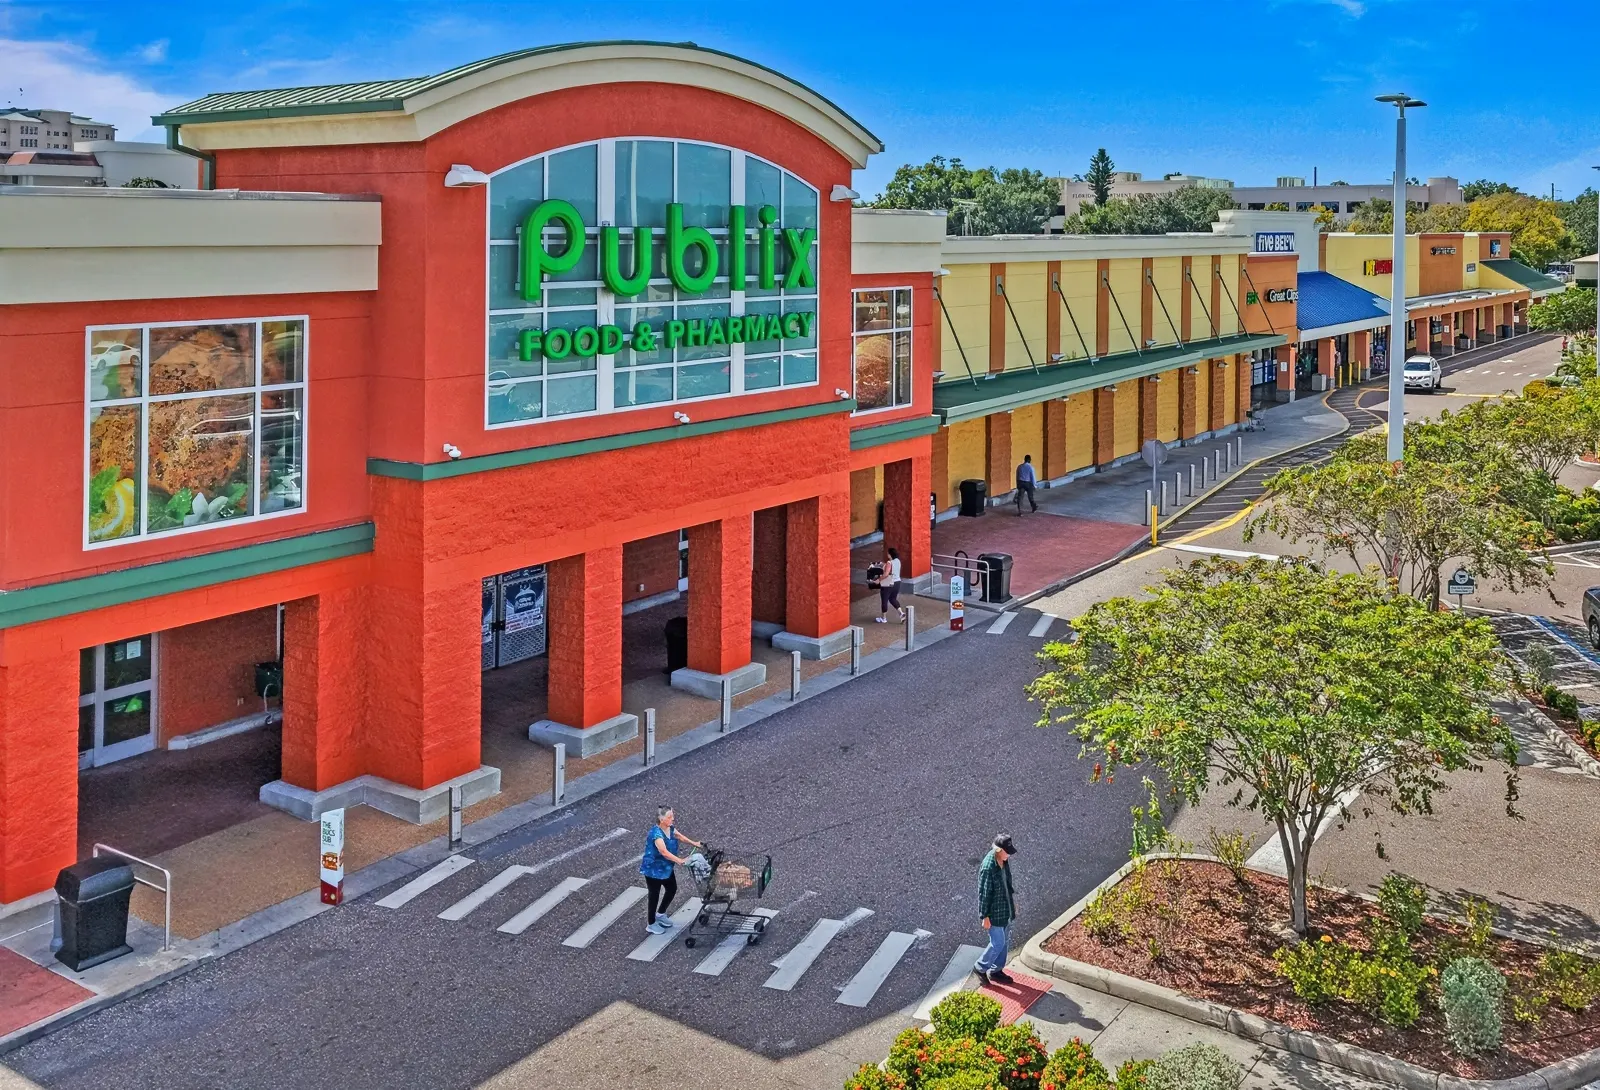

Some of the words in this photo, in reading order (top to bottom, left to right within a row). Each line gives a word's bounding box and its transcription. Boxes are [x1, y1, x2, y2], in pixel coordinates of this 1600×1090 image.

[519, 198, 816, 301] Publix
[1269, 289, 1286, 302] Great
[1286, 288, 1299, 303] Clips
[519, 324, 623, 361] FOOD
[632, 321, 657, 351] &
[664, 311, 815, 349] PHARMACY
[322, 820, 331, 829] THE
[322, 828, 336, 837] BUCS
[322, 835, 332, 843] SUB
